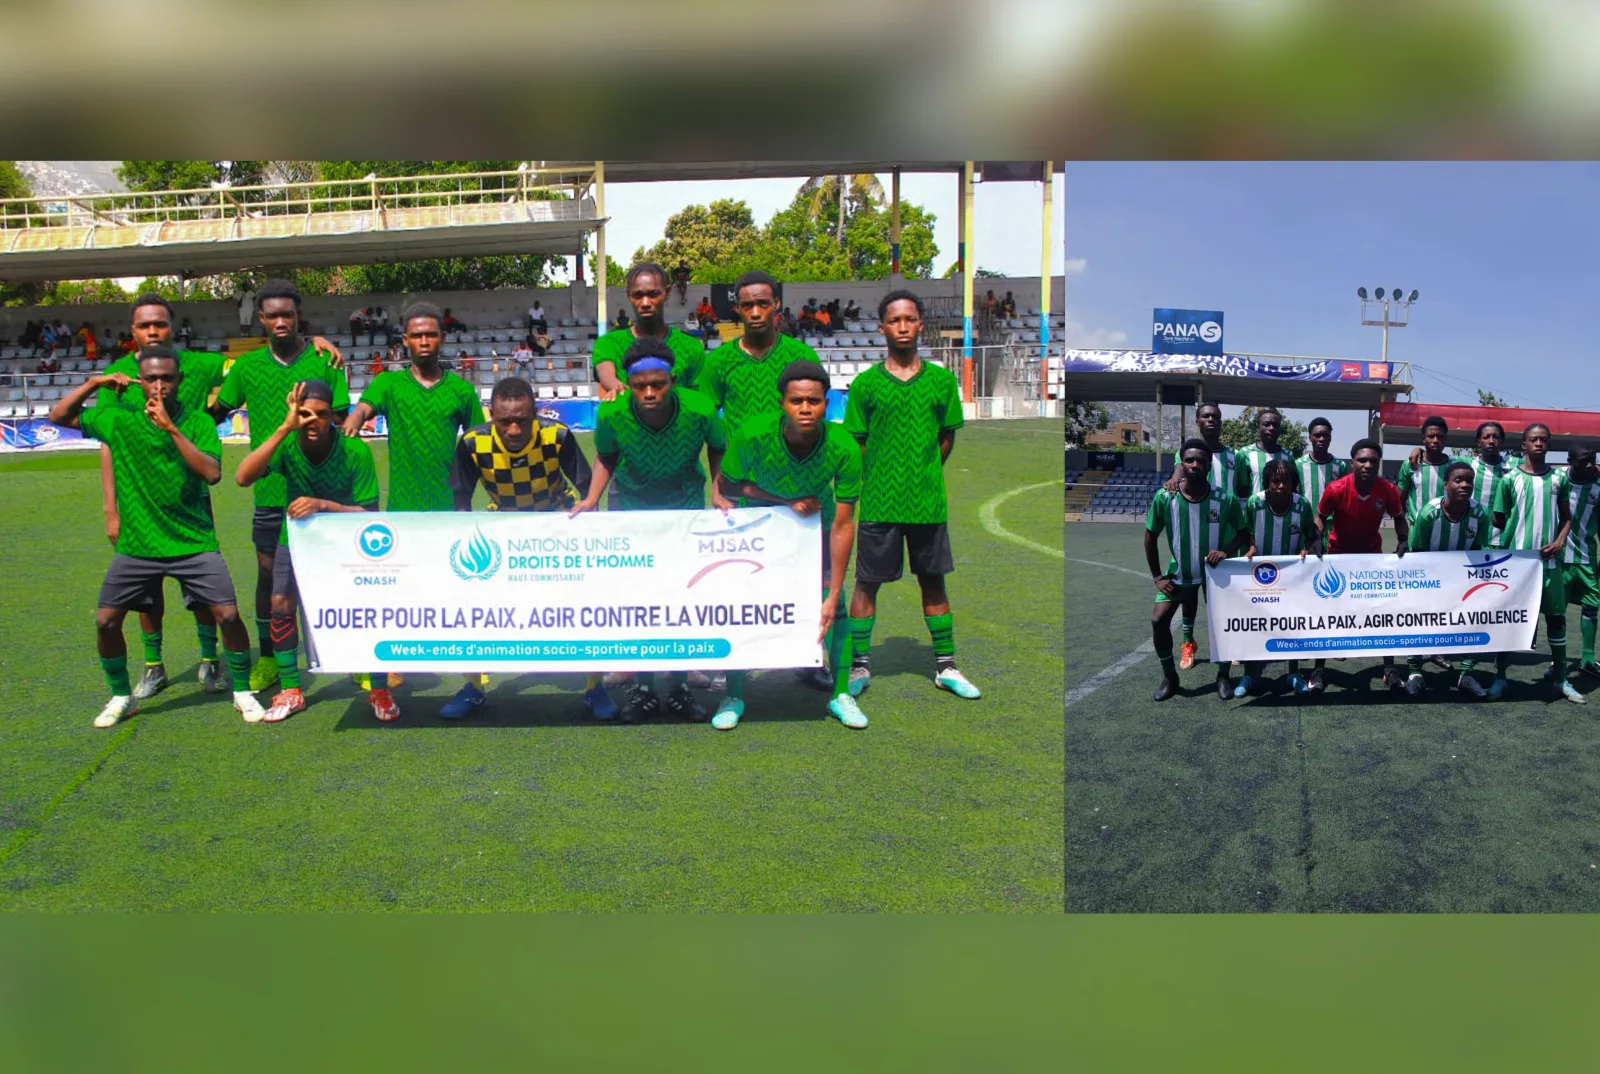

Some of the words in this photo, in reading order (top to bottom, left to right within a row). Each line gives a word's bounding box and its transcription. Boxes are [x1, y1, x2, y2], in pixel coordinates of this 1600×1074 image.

[1187, 360, 1248, 377] CASINO
[507, 538, 580, 552] NATIONS
[584, 537, 631, 551] UNIES
[697, 537, 765, 553] MJSAC
[508, 555, 561, 569] DROITS
[564, 555, 583, 568] DE
[586, 554, 655, 568] L'HOMME
[353, 576, 397, 586] ONASH
[1350, 570, 1394, 580] NATIONS
[1397, 569, 1426, 579] UNIES
[1467, 568, 1509, 579] MJSAC
[1350, 581, 1383, 591] DROITS
[1385, 580, 1396, 590] DE
[1399, 579, 1441, 590] L'HOMME
[313, 608, 377, 629] JOUER
[381, 607, 437, 629] POUR
[441, 607, 467, 628] LA
[527, 607, 575, 628] AGIR
[580, 605, 661, 628] CONTRE
[665, 605, 692, 627] LA
[695, 603, 795, 626] VIOLENCE
[1223, 617, 1267, 632] JOUER
[1270, 616, 1306, 631] POUR
[1308, 615, 1326, 630] LA
[1363, 613, 1394, 628] AGIR
[1396, 612, 1447, 627] CONTRE
[1449, 611, 1466, 626] LA
[1467, 609, 1528, 625] VIOLENCE
[389, 644, 463, 655] Week-ends
[466, 643, 539, 655] d'animation
[543, 643, 637, 657] socio-sportive
[640, 644, 670, 657] pour
[673, 642, 685, 654] la
[688, 642, 715, 656] paix
[1275, 639, 1324, 649] Week-ends
[1325, 638, 1372, 647] d'animation
[1374, 636, 1433, 646] socio-sportive
[1434, 636, 1453, 645] pour
[1454, 635, 1462, 643] la
[1463, 635, 1480, 644] paix
